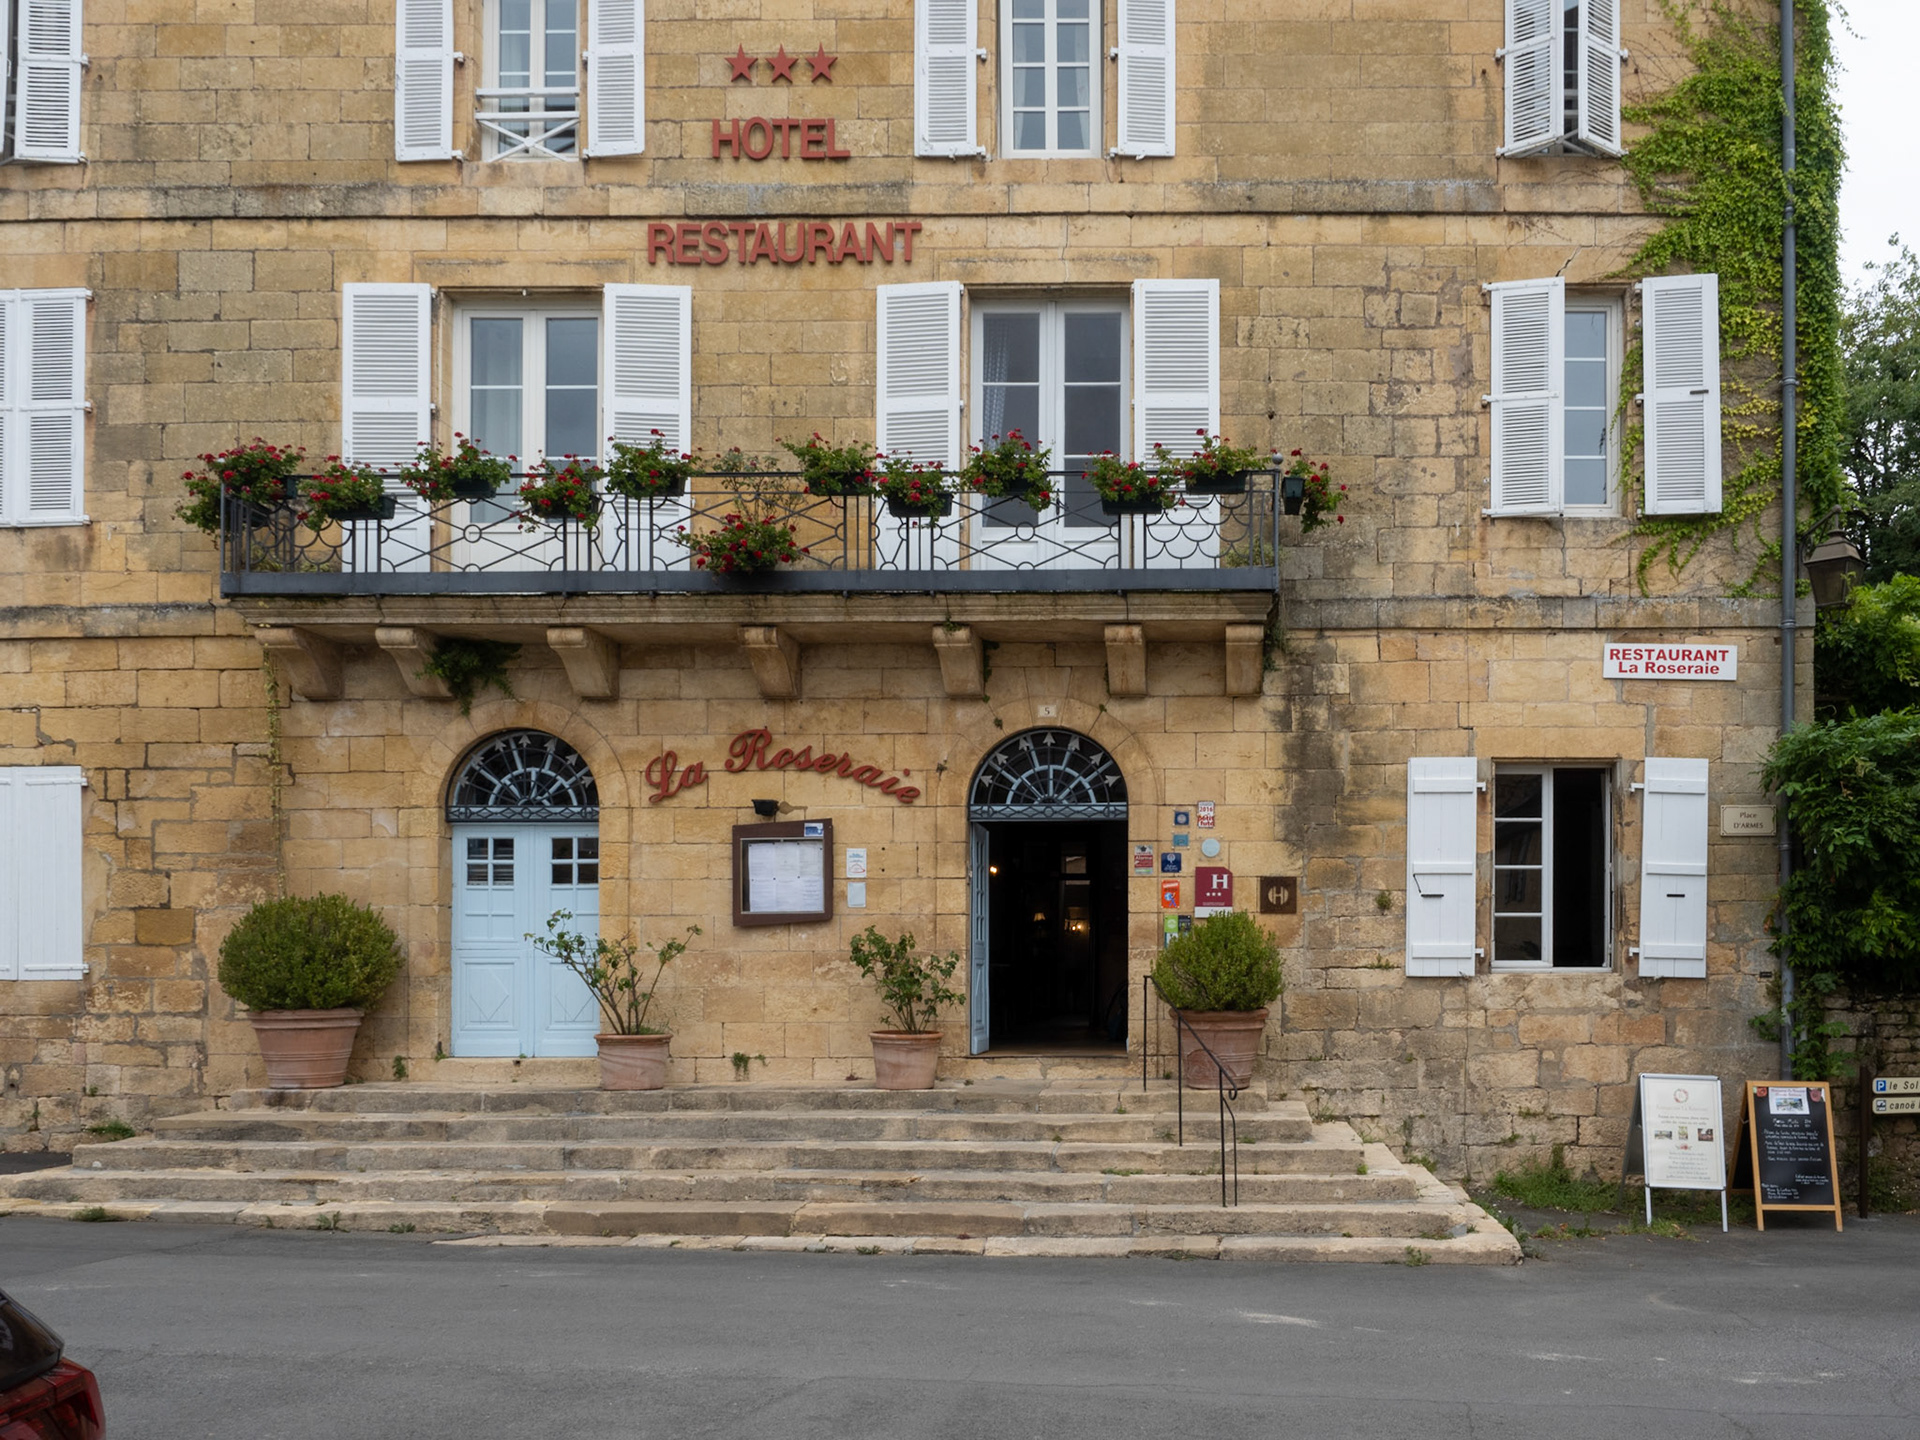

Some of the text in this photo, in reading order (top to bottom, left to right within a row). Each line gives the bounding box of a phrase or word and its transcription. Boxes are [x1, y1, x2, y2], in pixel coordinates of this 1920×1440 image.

[711, 116, 851, 160] HOTEL
[647, 221, 922, 265] RESTAURANT
[1609, 648, 1729, 662] RESTAURANT
[1618, 661, 1720, 675] La Roseraie
[645, 728, 921, 804] La Roseraie
[1739, 811, 1758, 819] Place
[1211, 873, 1229, 890] H
[1877, 1081, 1885, 1090] P
[1889, 1081, 1898, 1090] le
[1889, 1100, 1916, 1110] canoë
